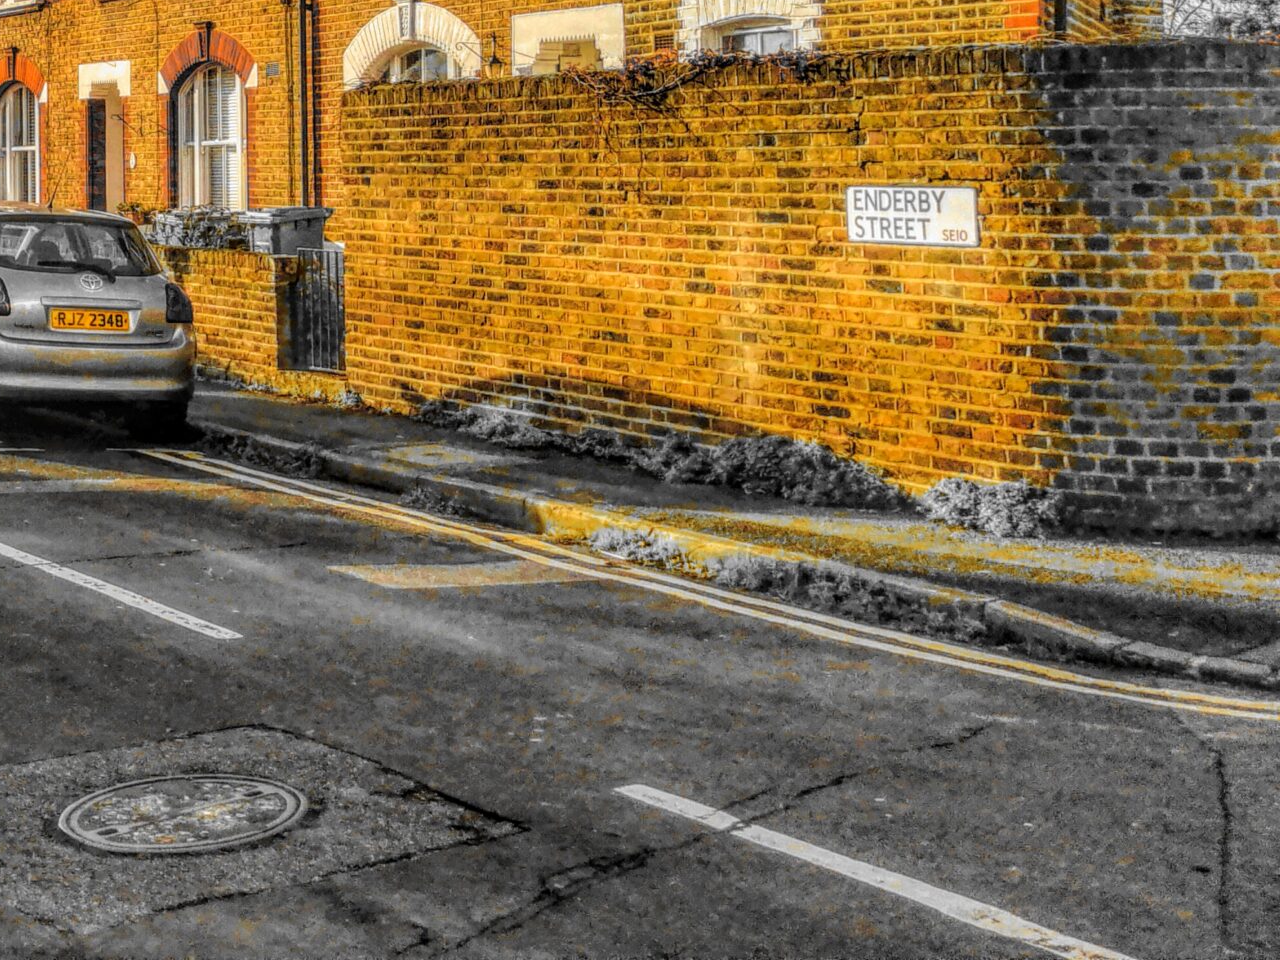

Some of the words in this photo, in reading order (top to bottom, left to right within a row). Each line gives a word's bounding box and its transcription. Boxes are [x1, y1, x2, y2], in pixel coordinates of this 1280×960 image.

[854, 189, 946, 213] ENDERBY
[855, 216, 930, 240] STREET
[942, 229, 968, 242] SE10
[58, 312, 85, 326] RJZ
[89, 313, 123, 327] 2348
